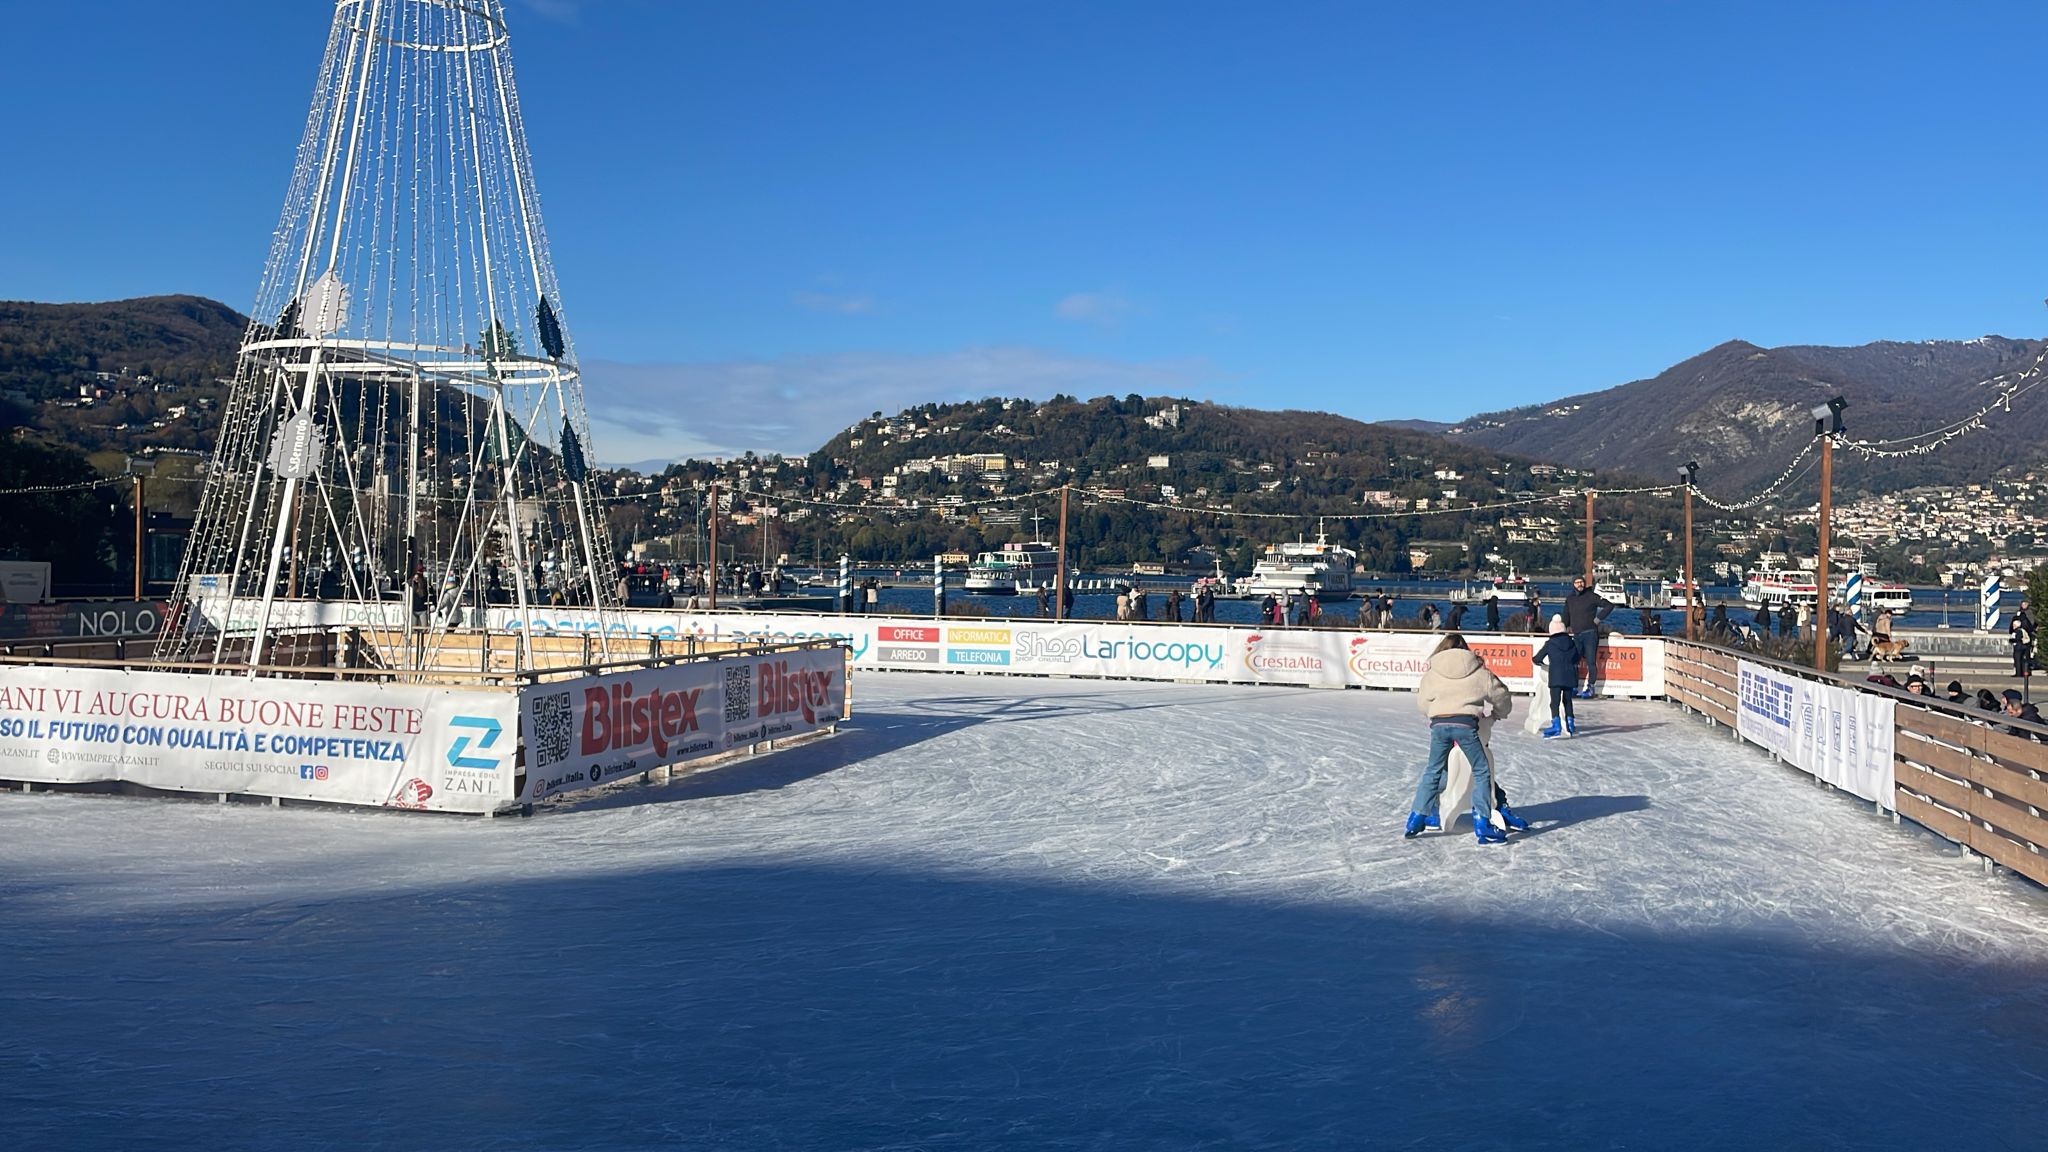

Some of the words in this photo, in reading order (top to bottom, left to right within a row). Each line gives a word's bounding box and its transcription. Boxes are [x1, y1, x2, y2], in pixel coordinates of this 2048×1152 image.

[287, 419, 308, 474] S.Bernardo
[80, 610, 155, 636] NOLO
[893, 629, 924, 641] OFFICE
[950, 630, 1009, 642] INFORMATICA
[1016, 631, 1081, 663] Shop
[1083, 634, 1223, 669] Lariocopy
[1473, 645, 1527, 658] GAZZINO
[890, 650, 926, 661] ARREDO
[955, 651, 1002, 663] TELEFONIA
[1253, 655, 1323, 669] CrestaAlta
[1492, 659, 1512, 667] PIZZA
[1358, 658, 1431, 673] CrestaAlta
[758, 659, 834, 725] Blistex
[0, 686, 47, 712] ANI
[53, 689, 83, 713] VI
[88, 691, 210, 723] AUGURA
[218, 697, 324, 728] BUONE
[332, 704, 423, 735] FESTE
[581, 681, 703, 759] Blistex
[28, 719, 45, 739] IL
[48, 720, 120, 743] FUTURO
[123, 725, 163, 746] CON
[167, 727, 249, 752] QUALITÀ
[254, 733, 267, 753] E
[271, 734, 407, 762] COMPETENZA
[61, 751, 160, 767] WWW.IMPRESAZANI.IT
[204, 760, 244, 771] SEGUICI
[246, 763, 262, 773] SUI
[264, 764, 299, 775] SOCIAL
[445, 778, 492, 794] ZANI
